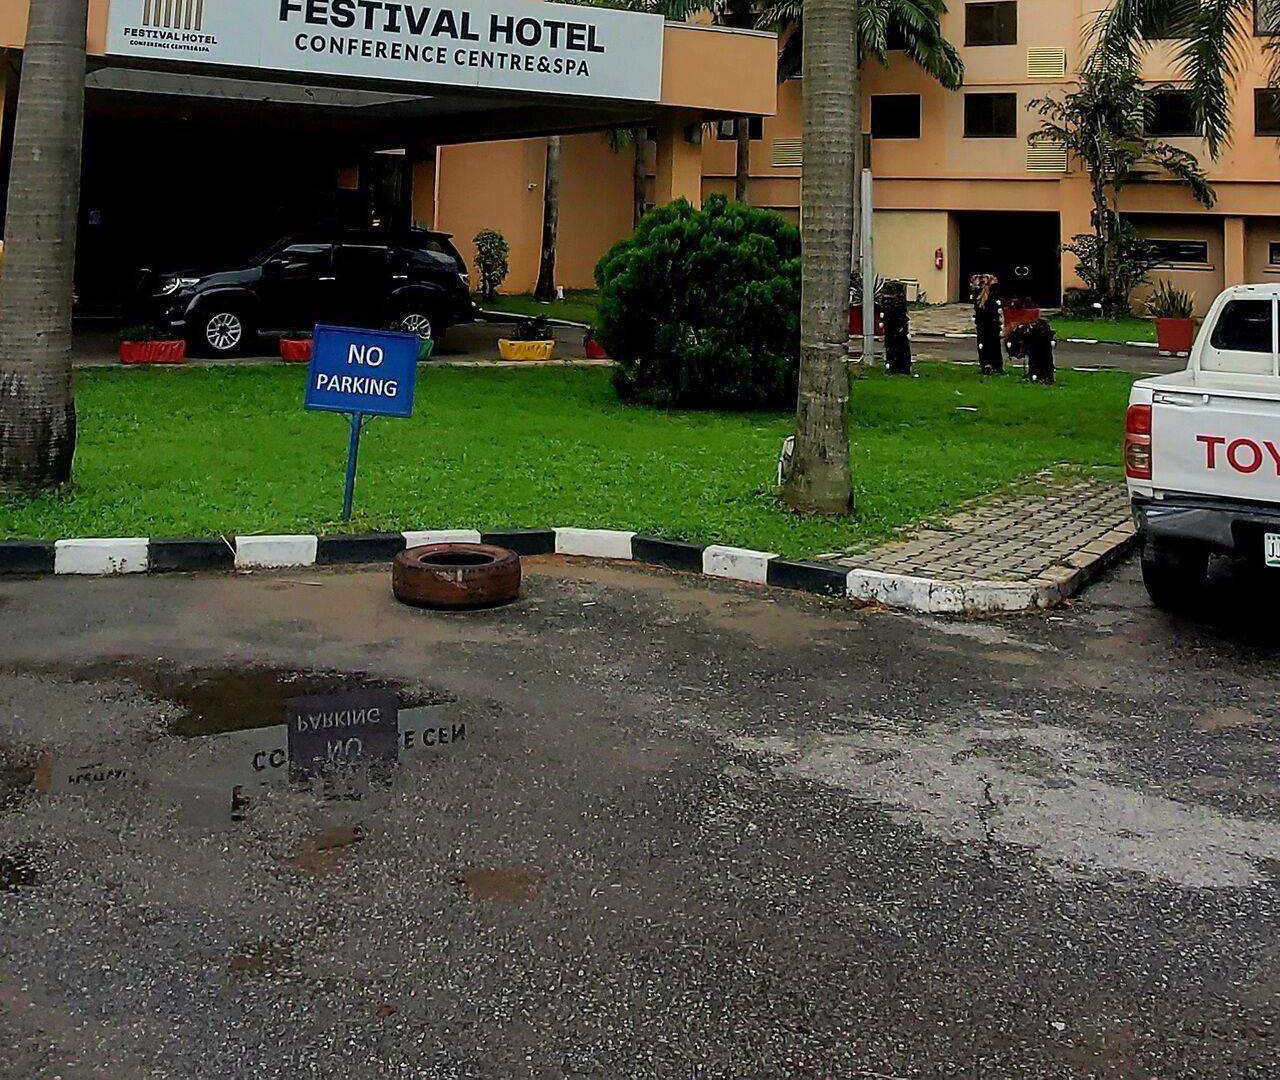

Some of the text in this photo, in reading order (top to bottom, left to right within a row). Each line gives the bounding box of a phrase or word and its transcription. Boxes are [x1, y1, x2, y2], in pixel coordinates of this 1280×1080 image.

[124, 28, 217, 44] FESTIVAL HOTEL
[130, 40, 170, 49] CONFERENCE
[488, 13, 605, 54] HOTEL
[295, 33, 590, 77] CONFERENCE CENTRE&SPA
[347, 344, 384, 367] NO
[316, 373, 398, 397] PARKING
